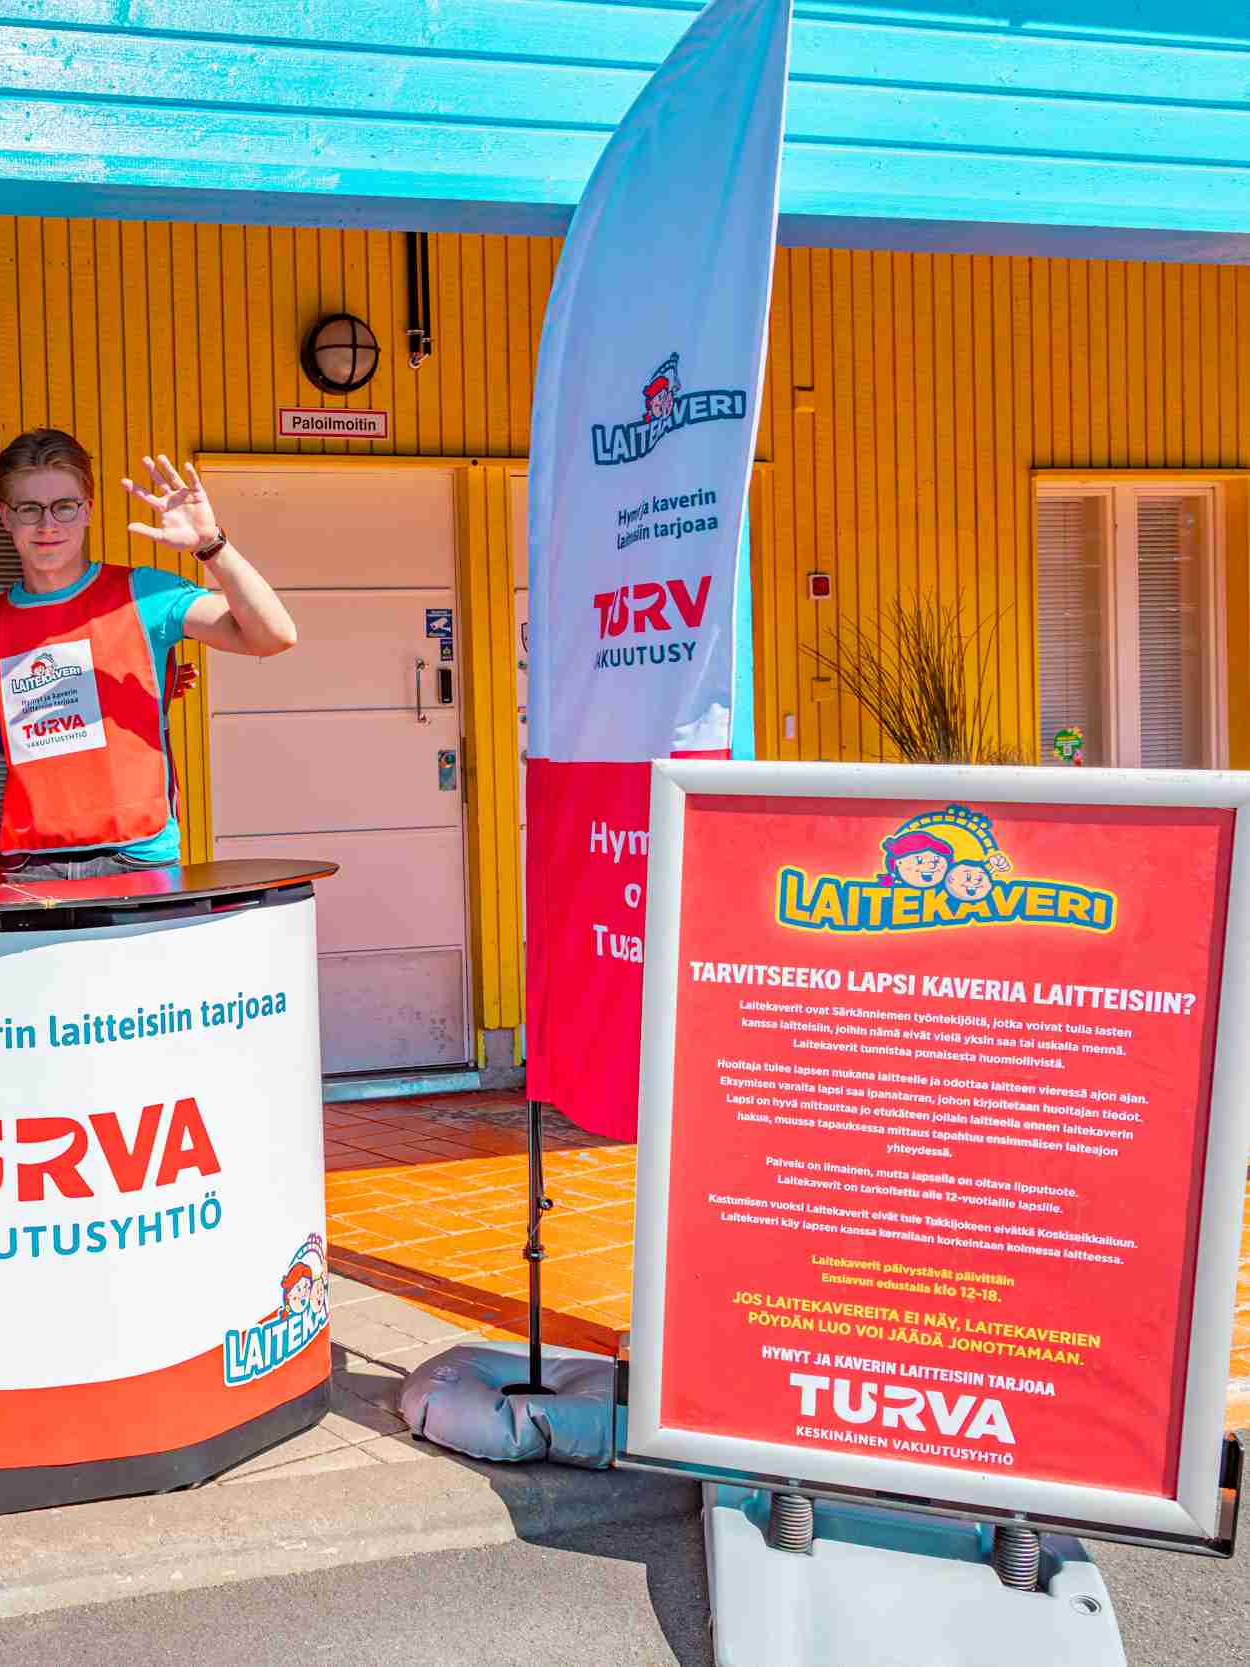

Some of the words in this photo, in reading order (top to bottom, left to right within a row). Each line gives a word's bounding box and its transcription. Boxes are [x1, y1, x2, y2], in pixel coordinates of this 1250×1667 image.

[293, 416, 376, 431] Paloilmoitin
[652, 488, 717, 514] kaverin
[654, 516, 719, 540] tarjoaa
[594, 576, 712, 640] TURV
[22, 714, 86, 740] TURVA
[781, 867, 1114, 931] LAITEKAVERI
[690, 961, 841, 990] TARVITSEEKO
[847, 970, 916, 996] LAPSI
[922, 976, 1027, 1003] KAVERIA
[1033, 982, 1196, 1015] LAITTEISIIN?
[49, 1002, 193, 1048] laitteisiin
[200, 991, 287, 1030] tarjoaa
[739, 1000, 803, 1013] Laitekaverit
[805, 1006, 830, 1016] ovat
[831, 1007, 911, 1021] Särkänniemen
[914, 1013, 991, 1029] työntekijöitä,
[993, 1018, 1023, 1030] jotka
[1026, 1021, 1063, 1033] voivat
[1066, 1024, 1093, 1035] tulla
[1094, 1025, 1132, 1038] lasten
[741, 1017, 779, 1029] kanssa
[780, 1020, 834, 1034] laitteisiin,
[835, 1024, 868, 1036] joihin
[869, 1027, 901, 1038] nämä
[903, 1029, 931, 1041] eivät
[934, 1032, 961, 1043] vielä
[964, 1034, 994, 1045] yksin
[996, 1038, 1017, 1047] saa
[1019, 1039, 1035, 1049] tai
[1038, 1040, 1080, 1052] uskalla
[1082, 1045, 1127, 1056] mennä.
[793, 1038, 858, 1053] Laitekaverit
[860, 1044, 912, 1057] tunnistaa
[914, 1048, 977, 1062] punaisesta
[978, 1053, 1065, 1069] huomioliivistä.
[717, 1059, 762, 1072] Huoltaja
[763, 1063, 792, 1073] tulee
[793, 1064, 830, 1077] lapsen
[832, 1069, 876, 1081] mukana
[877, 1072, 928, 1085] laitteelle
[929, 1076, 941, 1087] ja
[943, 1078, 989, 1090] odottaa
[991, 1081, 1036, 1094] laitteen
[1038, 1085, 1088, 1099] vieressä
[1089, 1090, 1117, 1102] ajon
[1119, 1093, 1149, 1105] ajan.
[720, 1076, 776, 1089] Eksymisen
[778, 1082, 816, 1093] varalta
[818, 1084, 844, 1096] lapsi
[846, 1088, 865, 1097] saa
[867, 1088, 935, 1105] ipanatarran,
[937, 1094, 971, 1106] johon
[973, 1097, 1040, 1112] kirjoitetaan
[1043, 1103, 1100, 1119] huoltajan
[1102, 1110, 1143, 1122] tiedot.
[726, 1093, 755, 1105] Lapsi
[756, 1097, 771, 1106] on
[772, 1097, 798, 1109] hyvä
[800, 1100, 858, 1114] mittauttaa
[860, 1105, 871, 1116] jo
[873, 1107, 930, 1121] etukäteen
[932, 1112, 968, 1124] jollain
[970, 1115, 1021, 1129] laitteella
[1023, 1121, 1061, 1133] ennen
[1063, 1123, 1134, 1140] laitekaverin
[777, 1174, 842, 1190] Laitekaverit
[843, 1183, 858, 1192] on
[860, 1184, 921, 1198] tarkoitettu
[921, 1190, 943, 1200] alle
[1018, 1200, 1063, 1214] lapsille.
[812, 1254, 882, 1272] Laitekaverit
[883, 1264, 954, 1280] päivystävät
[954, 1272, 1015, 1287] päivittäin
[821, 1272, 874, 1287] Ensiavun
[876, 1279, 931, 1294] edustalla
[933, 1282, 957, 1297] klo
[960, 1286, 1002, 1303] 12-18.
[732, 1291, 763, 1306] JOS
[766, 1295, 900, 1322] LAITEKAVEREITA
[904, 1311, 920, 1325] EI
[924, 1312, 961, 1333] NÄY,
[965, 1319, 1101, 1349] LAITEKAVERIEN
[748, 1310, 815, 1331] PÖYDÄN
[818, 1320, 851, 1335] LUO
[855, 1324, 884, 1339] VOI
[887, 1327, 944, 1348] JÄÄDÄ
[948, 1337, 1085, 1366] JONOTTAMAAN.
[225, 1314, 328, 1383] LAITEKA
[762, 1345, 811, 1364] HYMYT
[813, 1353, 832, 1367] JA
[834, 1355, 897, 1375] KAVERIN
[900, 1363, 985, 1386] LAITTEISIIN
[987, 1374, 1056, 1397] TARJOAA
[789, 1372, 1016, 1445] TURVA
[796, 1425, 888, 1448] KESKINÄINEN
[892, 1439, 1014, 1466] VAKUUTUSYHTIÖ
